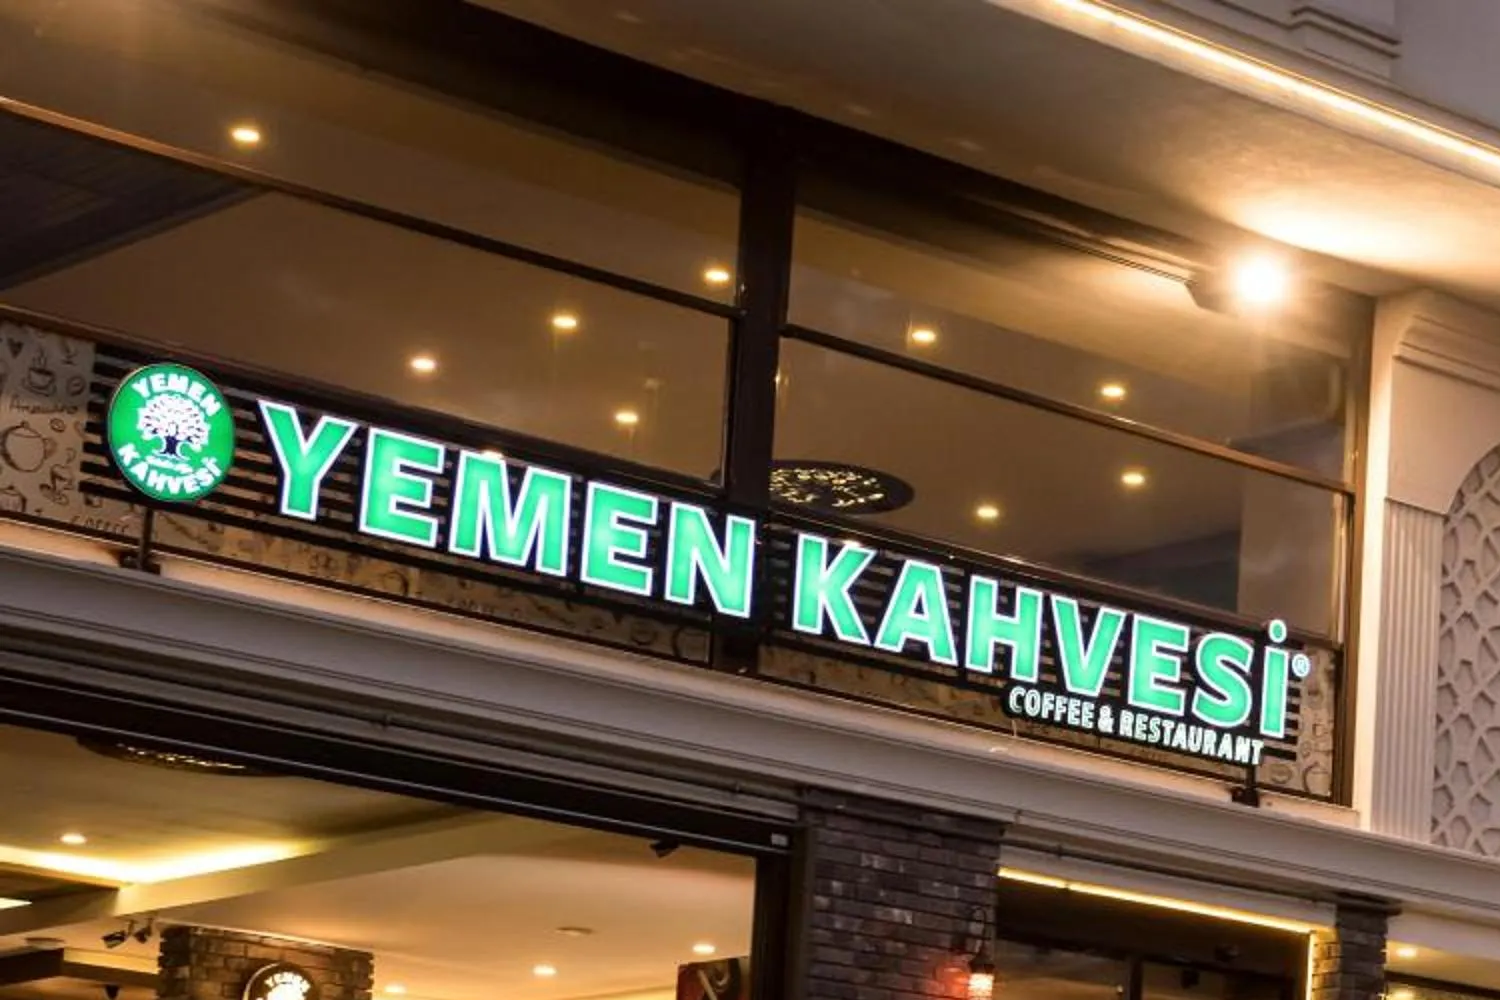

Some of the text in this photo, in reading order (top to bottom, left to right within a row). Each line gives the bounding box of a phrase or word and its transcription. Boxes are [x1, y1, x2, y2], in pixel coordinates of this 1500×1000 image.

[131, 373, 222, 416] YEMEN
[257, 399, 1288, 739] YEMEN KAHVESİ
[1008, 686, 1265, 766] COFFEE & RESTAURANT
